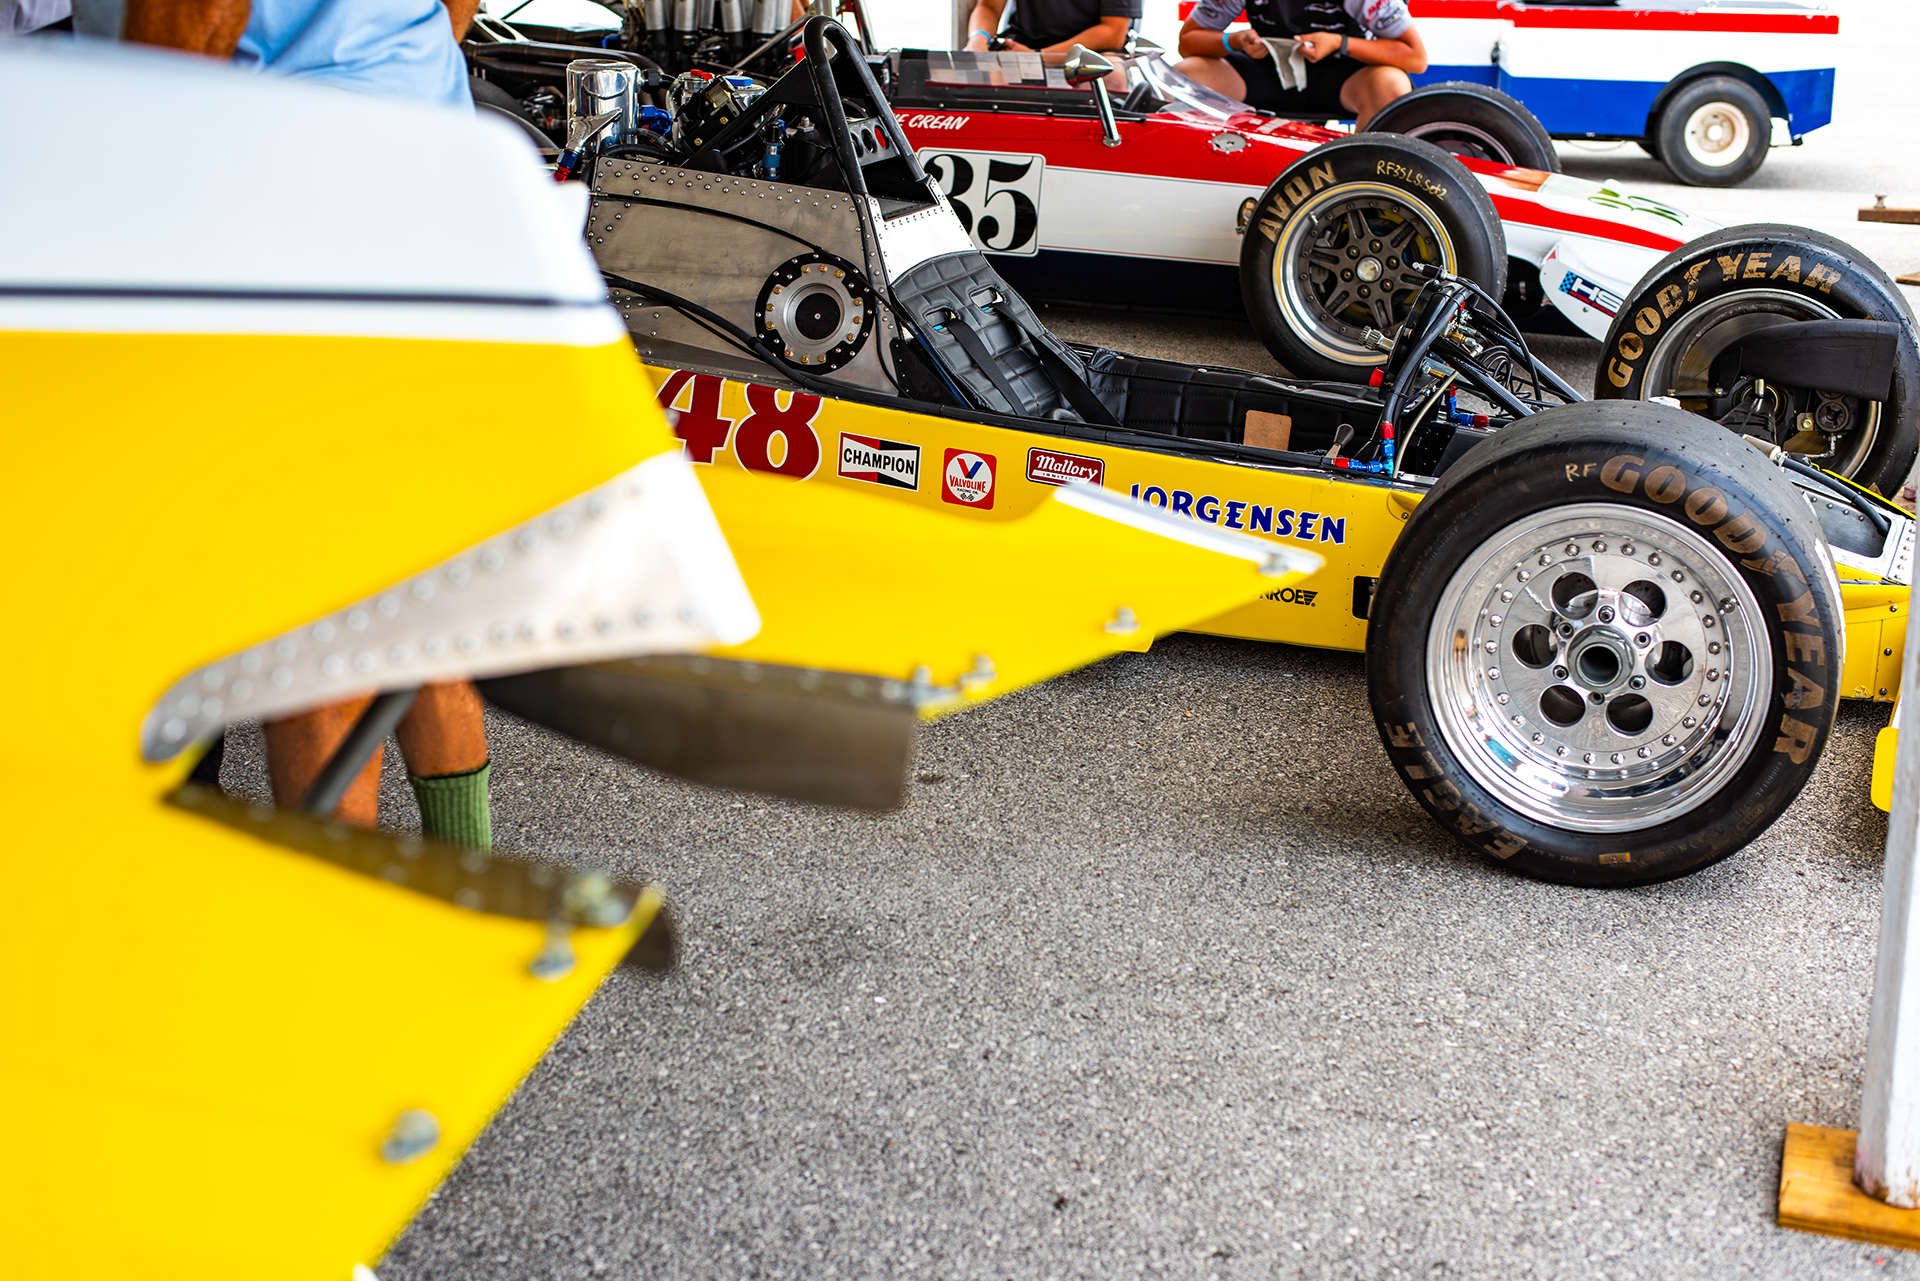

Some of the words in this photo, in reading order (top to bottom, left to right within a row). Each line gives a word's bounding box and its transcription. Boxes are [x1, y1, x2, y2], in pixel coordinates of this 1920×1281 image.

[908, 114, 970, 130] CREAN
[924, 153, 1038, 251] 35
[1257, 160, 1339, 244] AVON
[1571, 277, 1623, 313] HS
[655, 369, 825, 481] 48
[843, 448, 915, 475] CHAMPION
[1036, 454, 1098, 482] Mallory
[1042, 471, 1079, 483] IGNITION
[1565, 462, 1597, 482] RF
[1129, 482, 1347, 545] JORGENSEN
[1257, 587, 1304, 605] NROE
[1383, 721, 1529, 860] EAGLE
